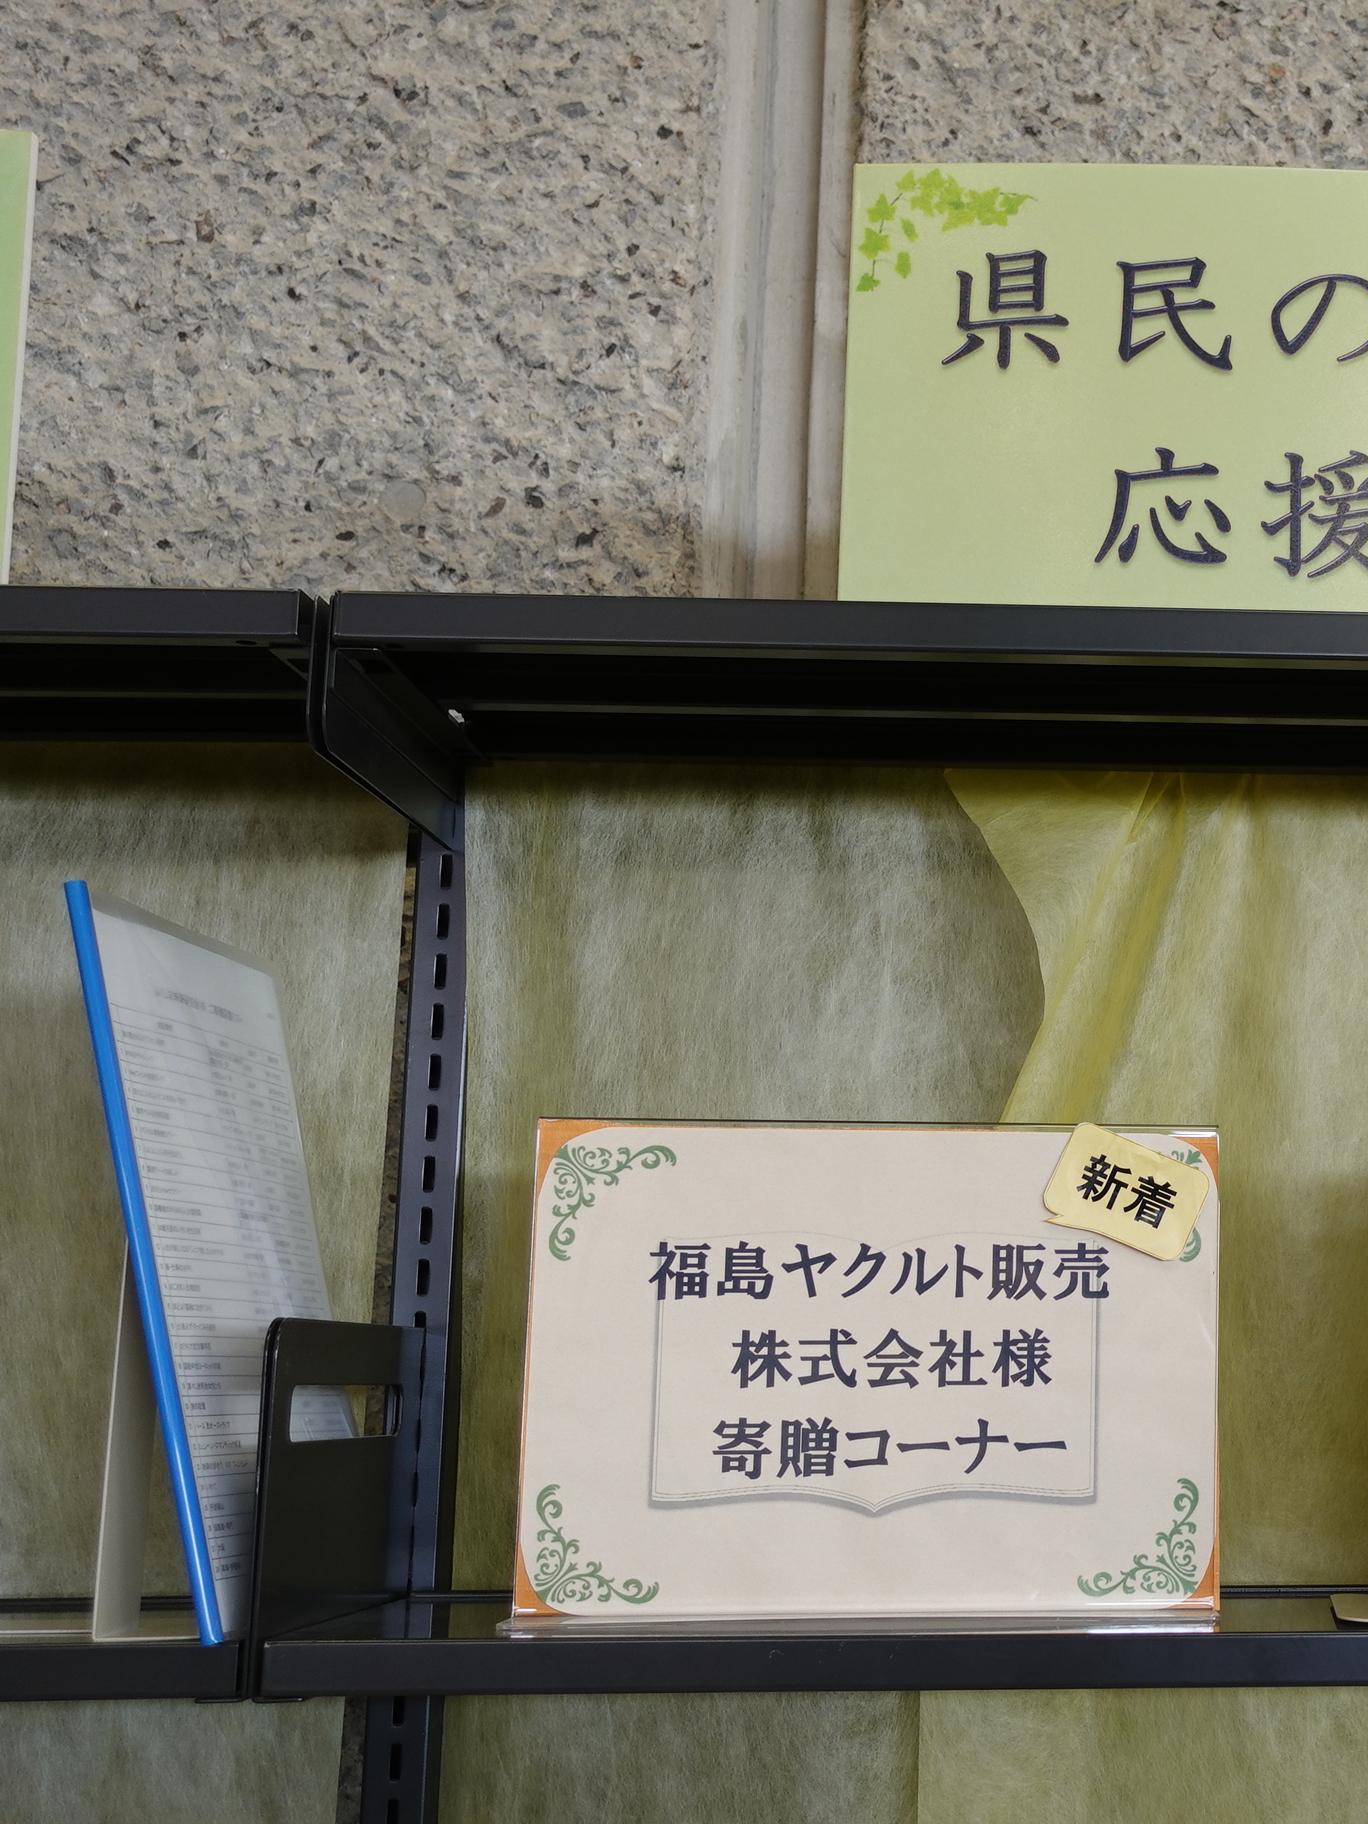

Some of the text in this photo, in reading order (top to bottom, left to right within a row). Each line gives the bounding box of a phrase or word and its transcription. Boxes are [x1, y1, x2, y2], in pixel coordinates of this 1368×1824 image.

[1075, 1152, 1177, 1230] 新着
[648, 1239, 1112, 1303] 福島ヤクルト販売
[730, 1326, 1054, 1389] 株式会社様
[712, 1416, 1069, 1480] 寄贈コーナー
